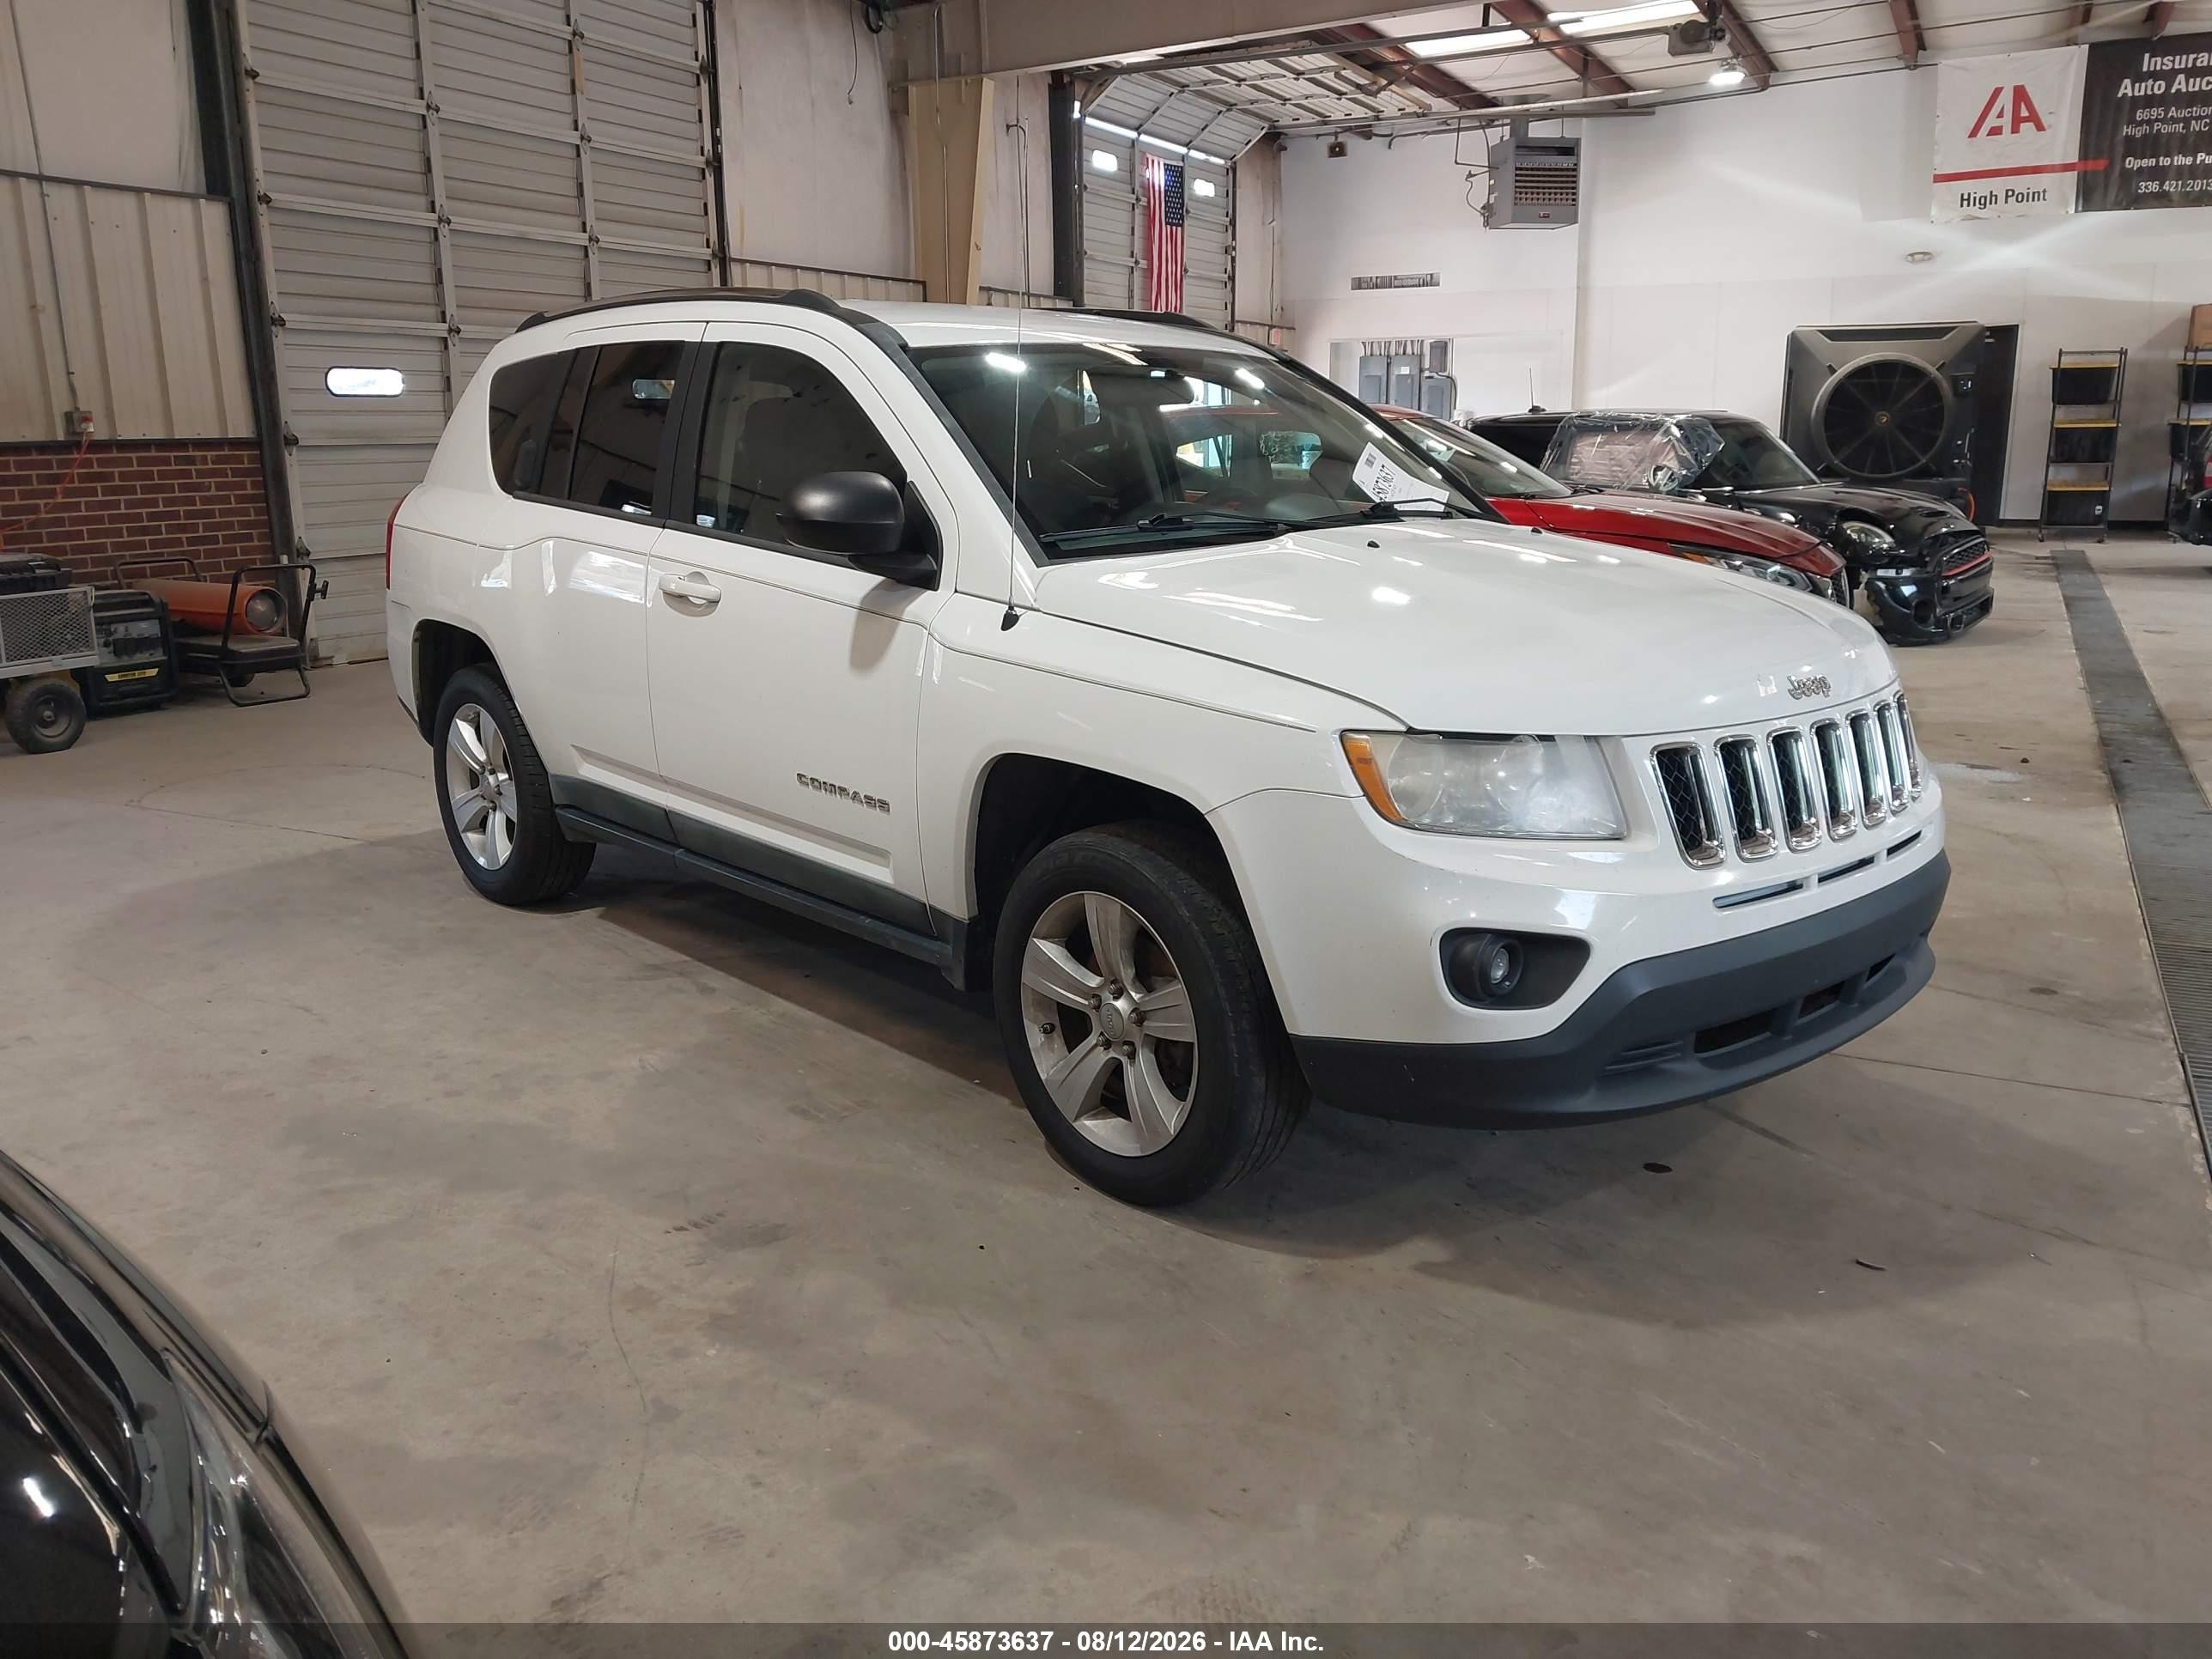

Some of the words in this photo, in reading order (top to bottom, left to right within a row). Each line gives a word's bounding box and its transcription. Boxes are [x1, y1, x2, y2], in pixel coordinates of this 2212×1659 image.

[2142, 52, 2212, 72] Insura
[2117, 78, 2166, 98] Auto
[2171, 73, 2212, 94] Auc
[2136, 106, 2165, 121] 6695
[2123, 123, 2150, 138] High
[2154, 121, 2186, 135] Point,
[2191, 118, 2210, 131] NC
[2125, 156, 2156, 171] Open
[2159, 155, 2171, 167] to
[2173, 154, 2193, 167] the
[1960, 190, 1999, 210] High
[2004, 186, 2048, 205] Point
[1786, 674, 1832, 701] Jeep
[796, 772, 891, 814] COMPASS
